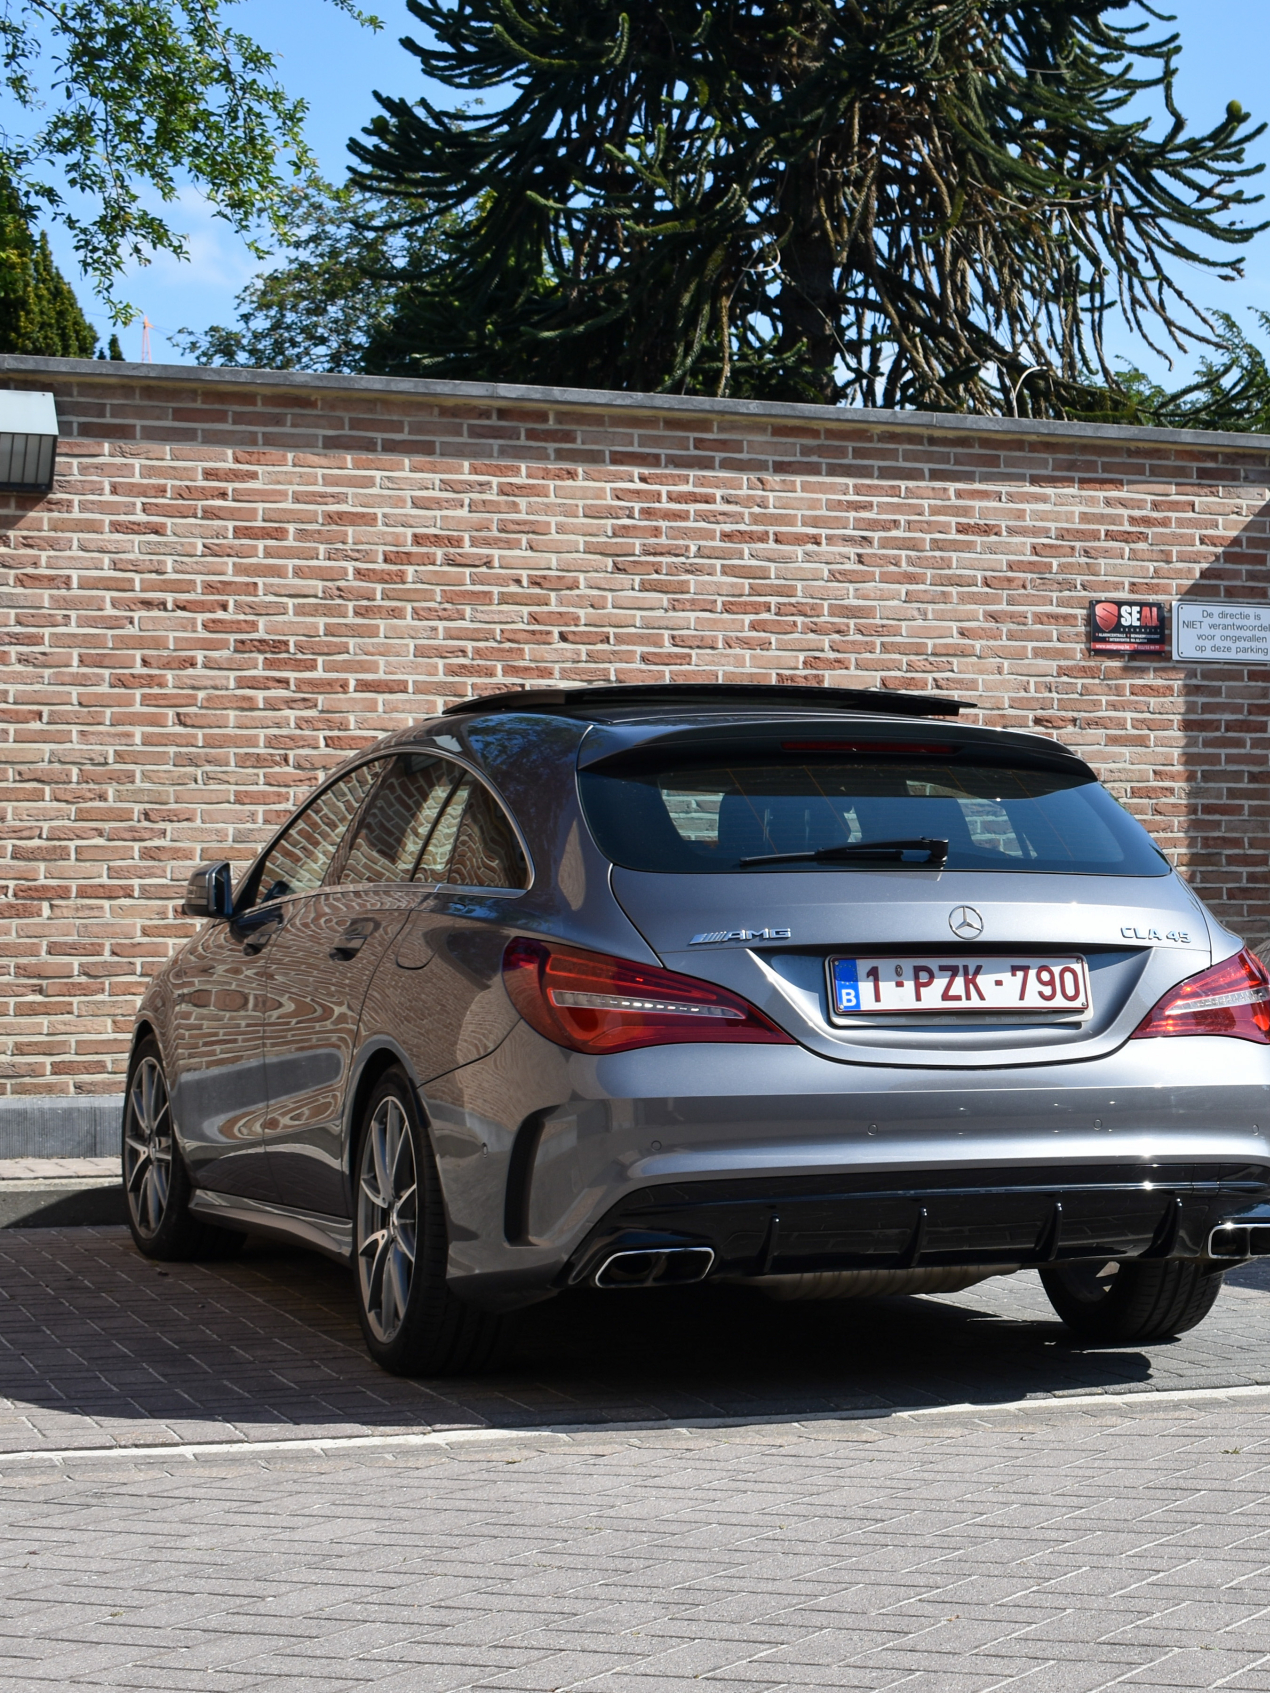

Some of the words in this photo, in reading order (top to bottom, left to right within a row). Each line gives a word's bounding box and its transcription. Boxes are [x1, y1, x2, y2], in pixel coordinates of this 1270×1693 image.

[1120, 605, 1160, 626] SEAL
[1201, 609, 1214, 619] De
[1218, 610, 1251, 620] directie
[1254, 611, 1261, 620] is
[1182, 620, 1204, 629] NIET
[1196, 633, 1216, 641] voor
[1219, 634, 1268, 644] ongevallen
[1194, 645, 1206, 653] op
[1210, 644, 1232, 653] deze
[1235, 645, 1269, 656] parking
[725, 927, 792, 943] AMG
[1119, 926, 1162, 941] CLA
[1164, 929, 1192, 945] 45
[865, 963, 1081, 1006] 1-PZK-790
[842, 988, 857, 1007] B
